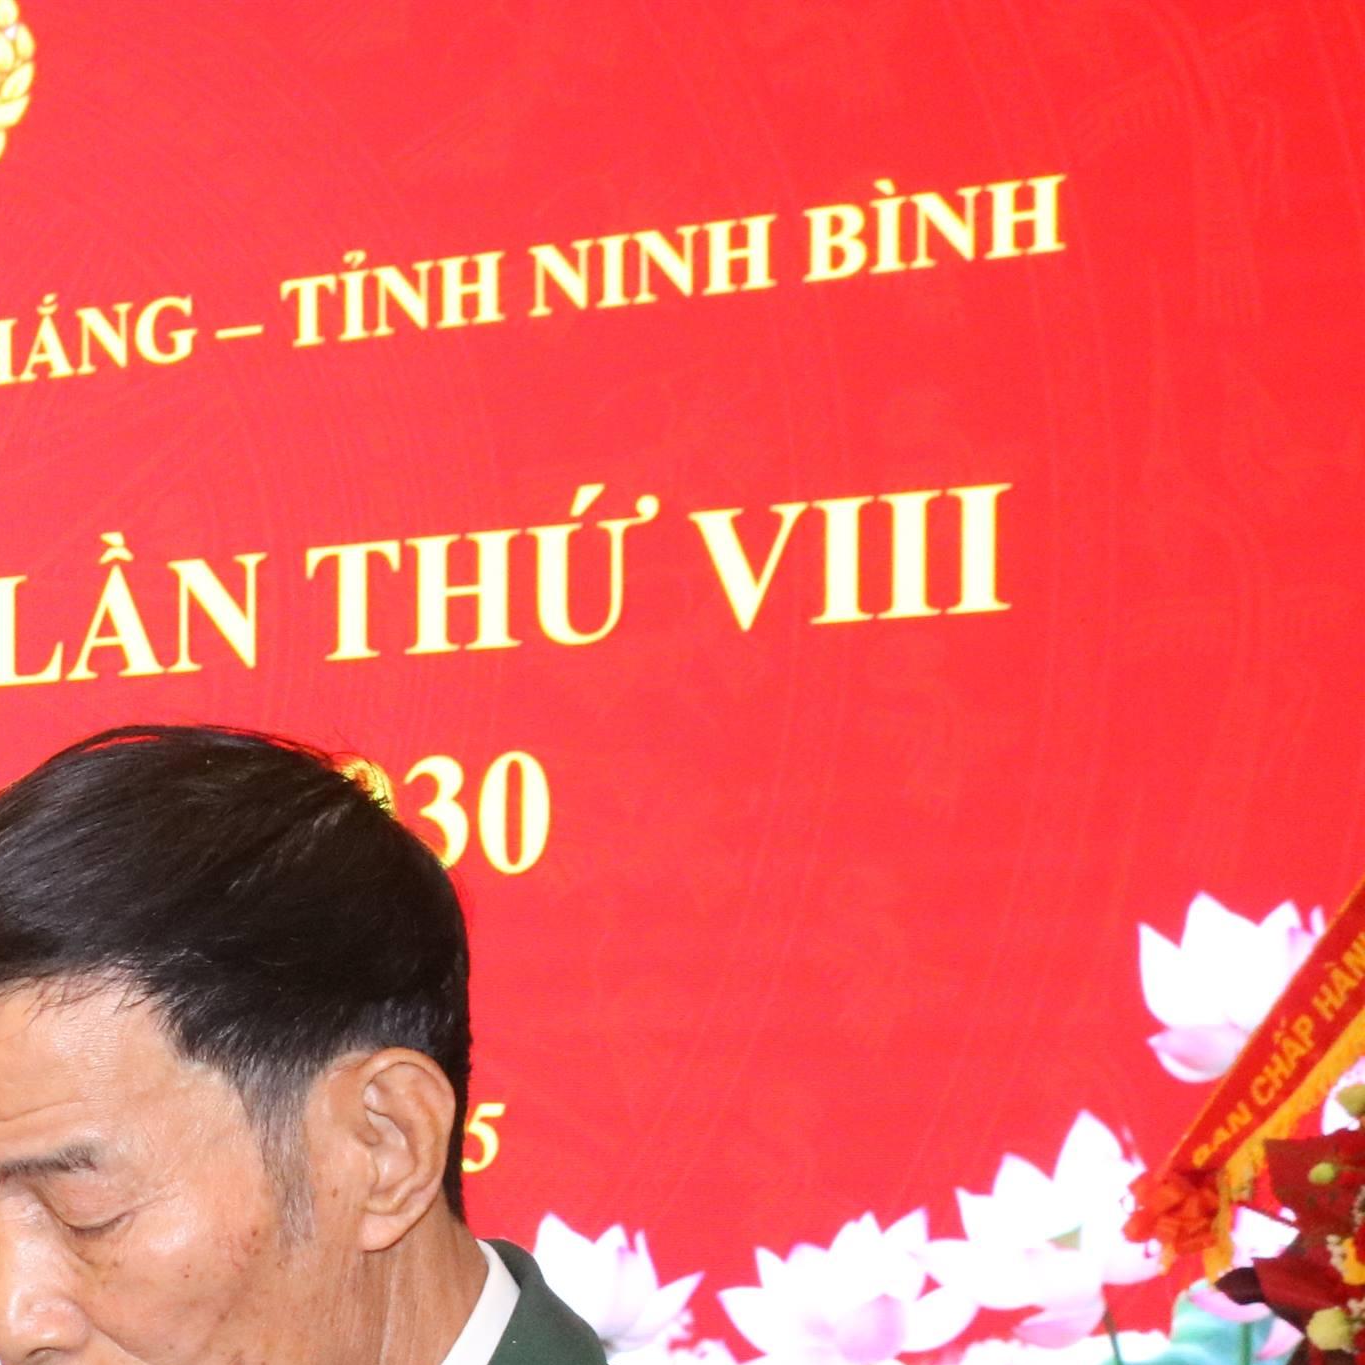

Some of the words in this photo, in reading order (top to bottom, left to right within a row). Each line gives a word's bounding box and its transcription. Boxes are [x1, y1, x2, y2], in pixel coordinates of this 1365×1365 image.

[280, 250, 505, 347] TỈNH
[529, 214, 776, 317] NINH
[804, 175, 1065, 282] BÌNH
[305, 483, 659, 661] THỨ
[689, 483, 1011, 631] VIII
